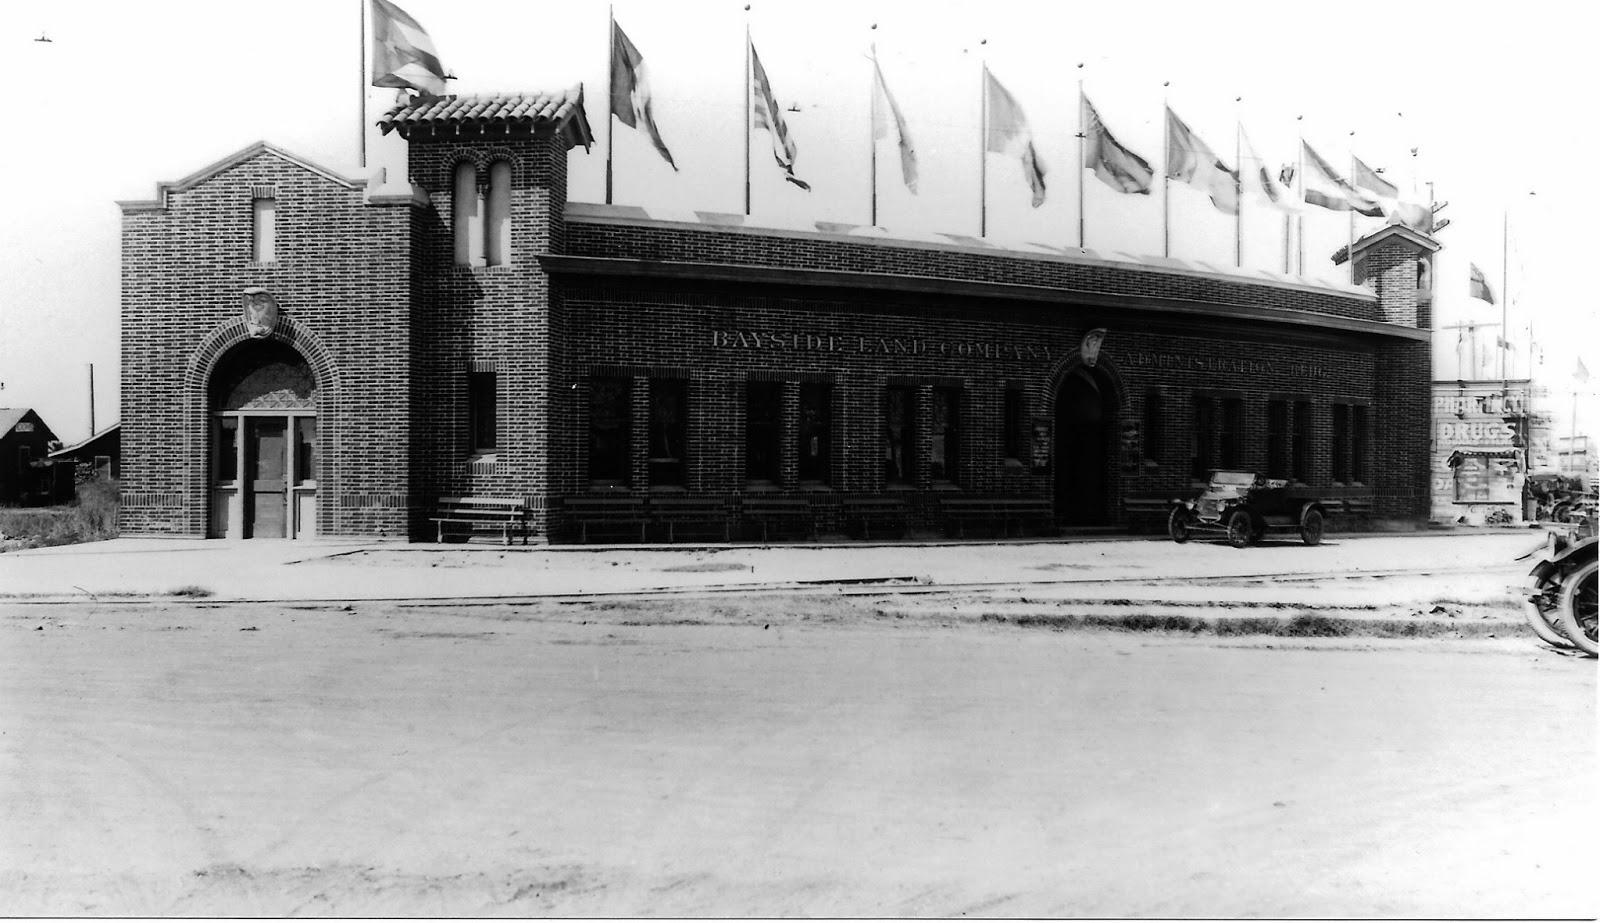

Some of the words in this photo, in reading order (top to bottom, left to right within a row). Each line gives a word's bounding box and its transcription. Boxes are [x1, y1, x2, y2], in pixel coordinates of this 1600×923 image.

[711, 330, 844, 352] BAYSIDE
[858, 336, 928, 355] LAND
[940, 340, 1052, 361] COMPANY
[1440, 422, 1517, 440] DRUGS
